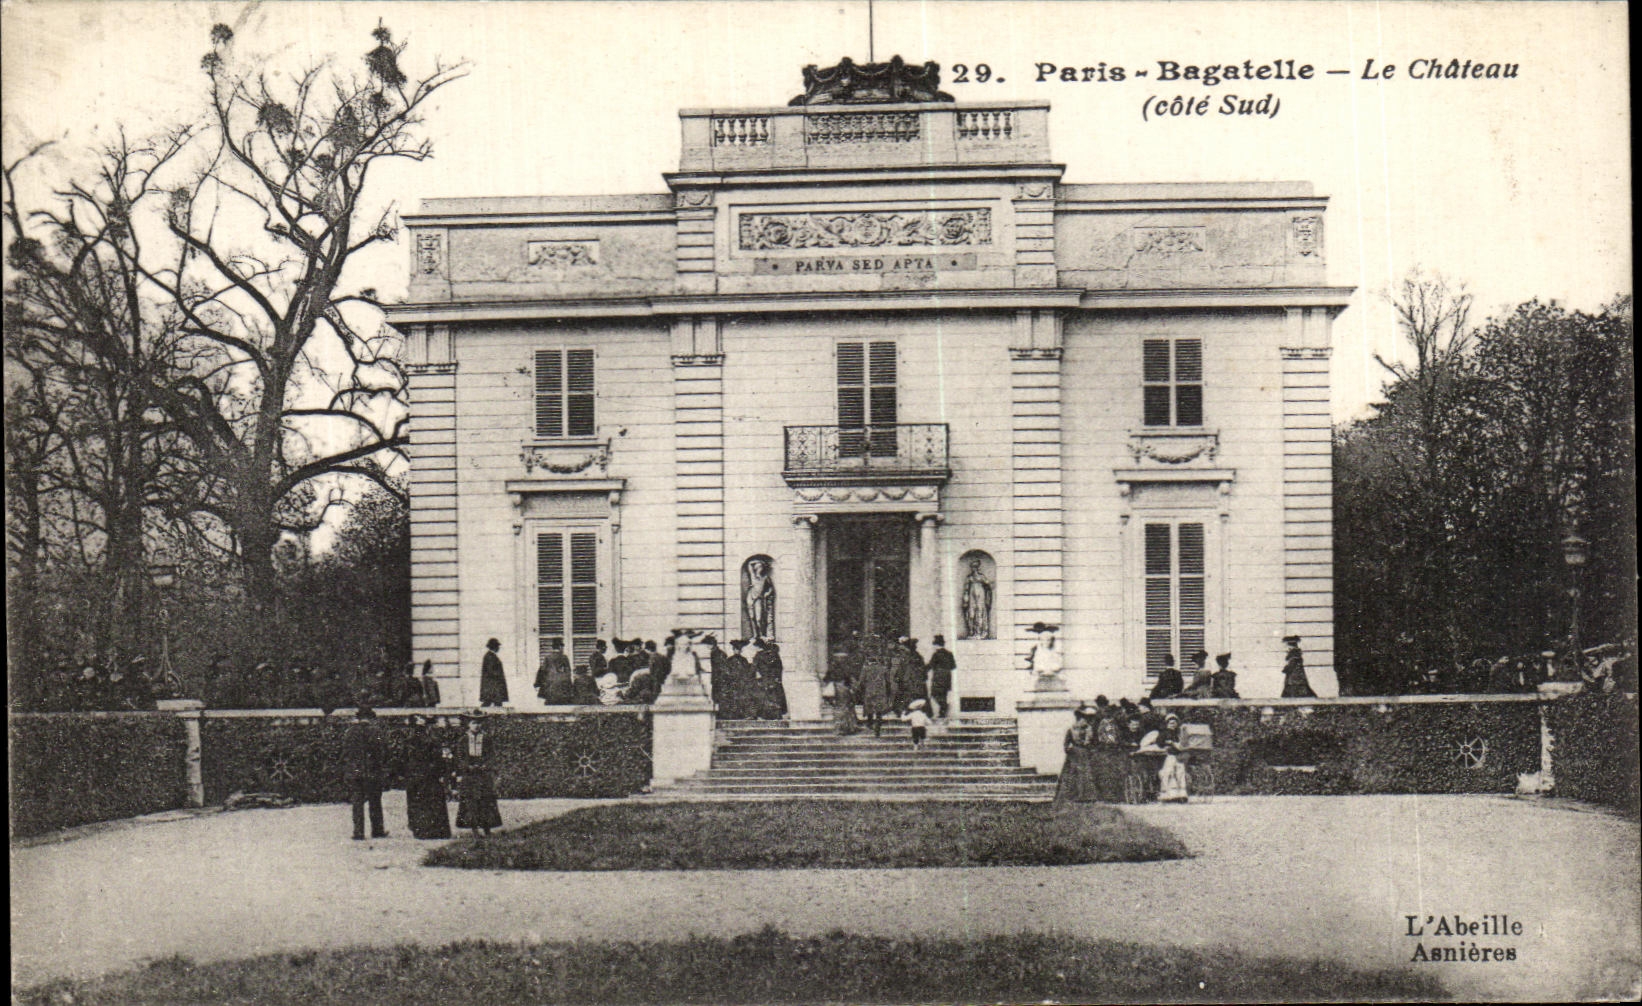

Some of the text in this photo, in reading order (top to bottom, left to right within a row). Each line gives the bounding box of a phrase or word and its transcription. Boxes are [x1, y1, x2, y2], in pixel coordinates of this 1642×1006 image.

[795, 257, 933, 273] PARVA SED APTA
